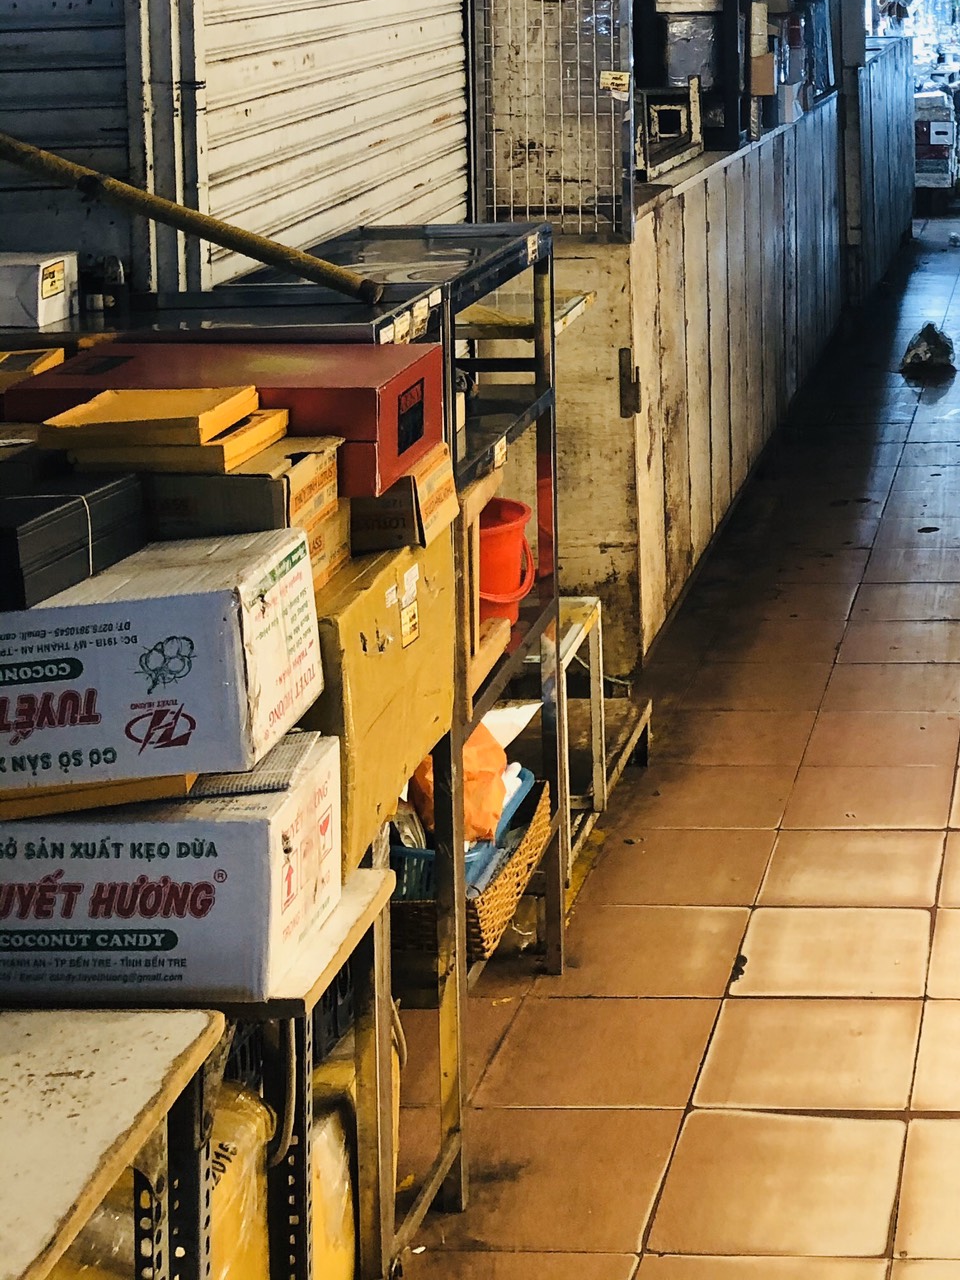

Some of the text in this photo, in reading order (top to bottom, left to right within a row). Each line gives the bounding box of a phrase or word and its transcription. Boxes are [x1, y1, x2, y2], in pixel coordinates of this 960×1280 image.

[21, 644, 34, 655] AN
[11, 752, 53, 777] SẢN
[58, 749, 84, 774] SỞ
[24, 836, 65, 860] SẢN
[70, 836, 125, 860] XUẤT
[129, 841, 171, 862] KẸO
[176, 837, 218, 859] DỪA
[88, 874, 216, 919] HƯƠNG
[0, 933, 165, 947] COCONUT CANDY
[92, 958, 111, 968] TRE
[168, 958, 188, 968] TRE
